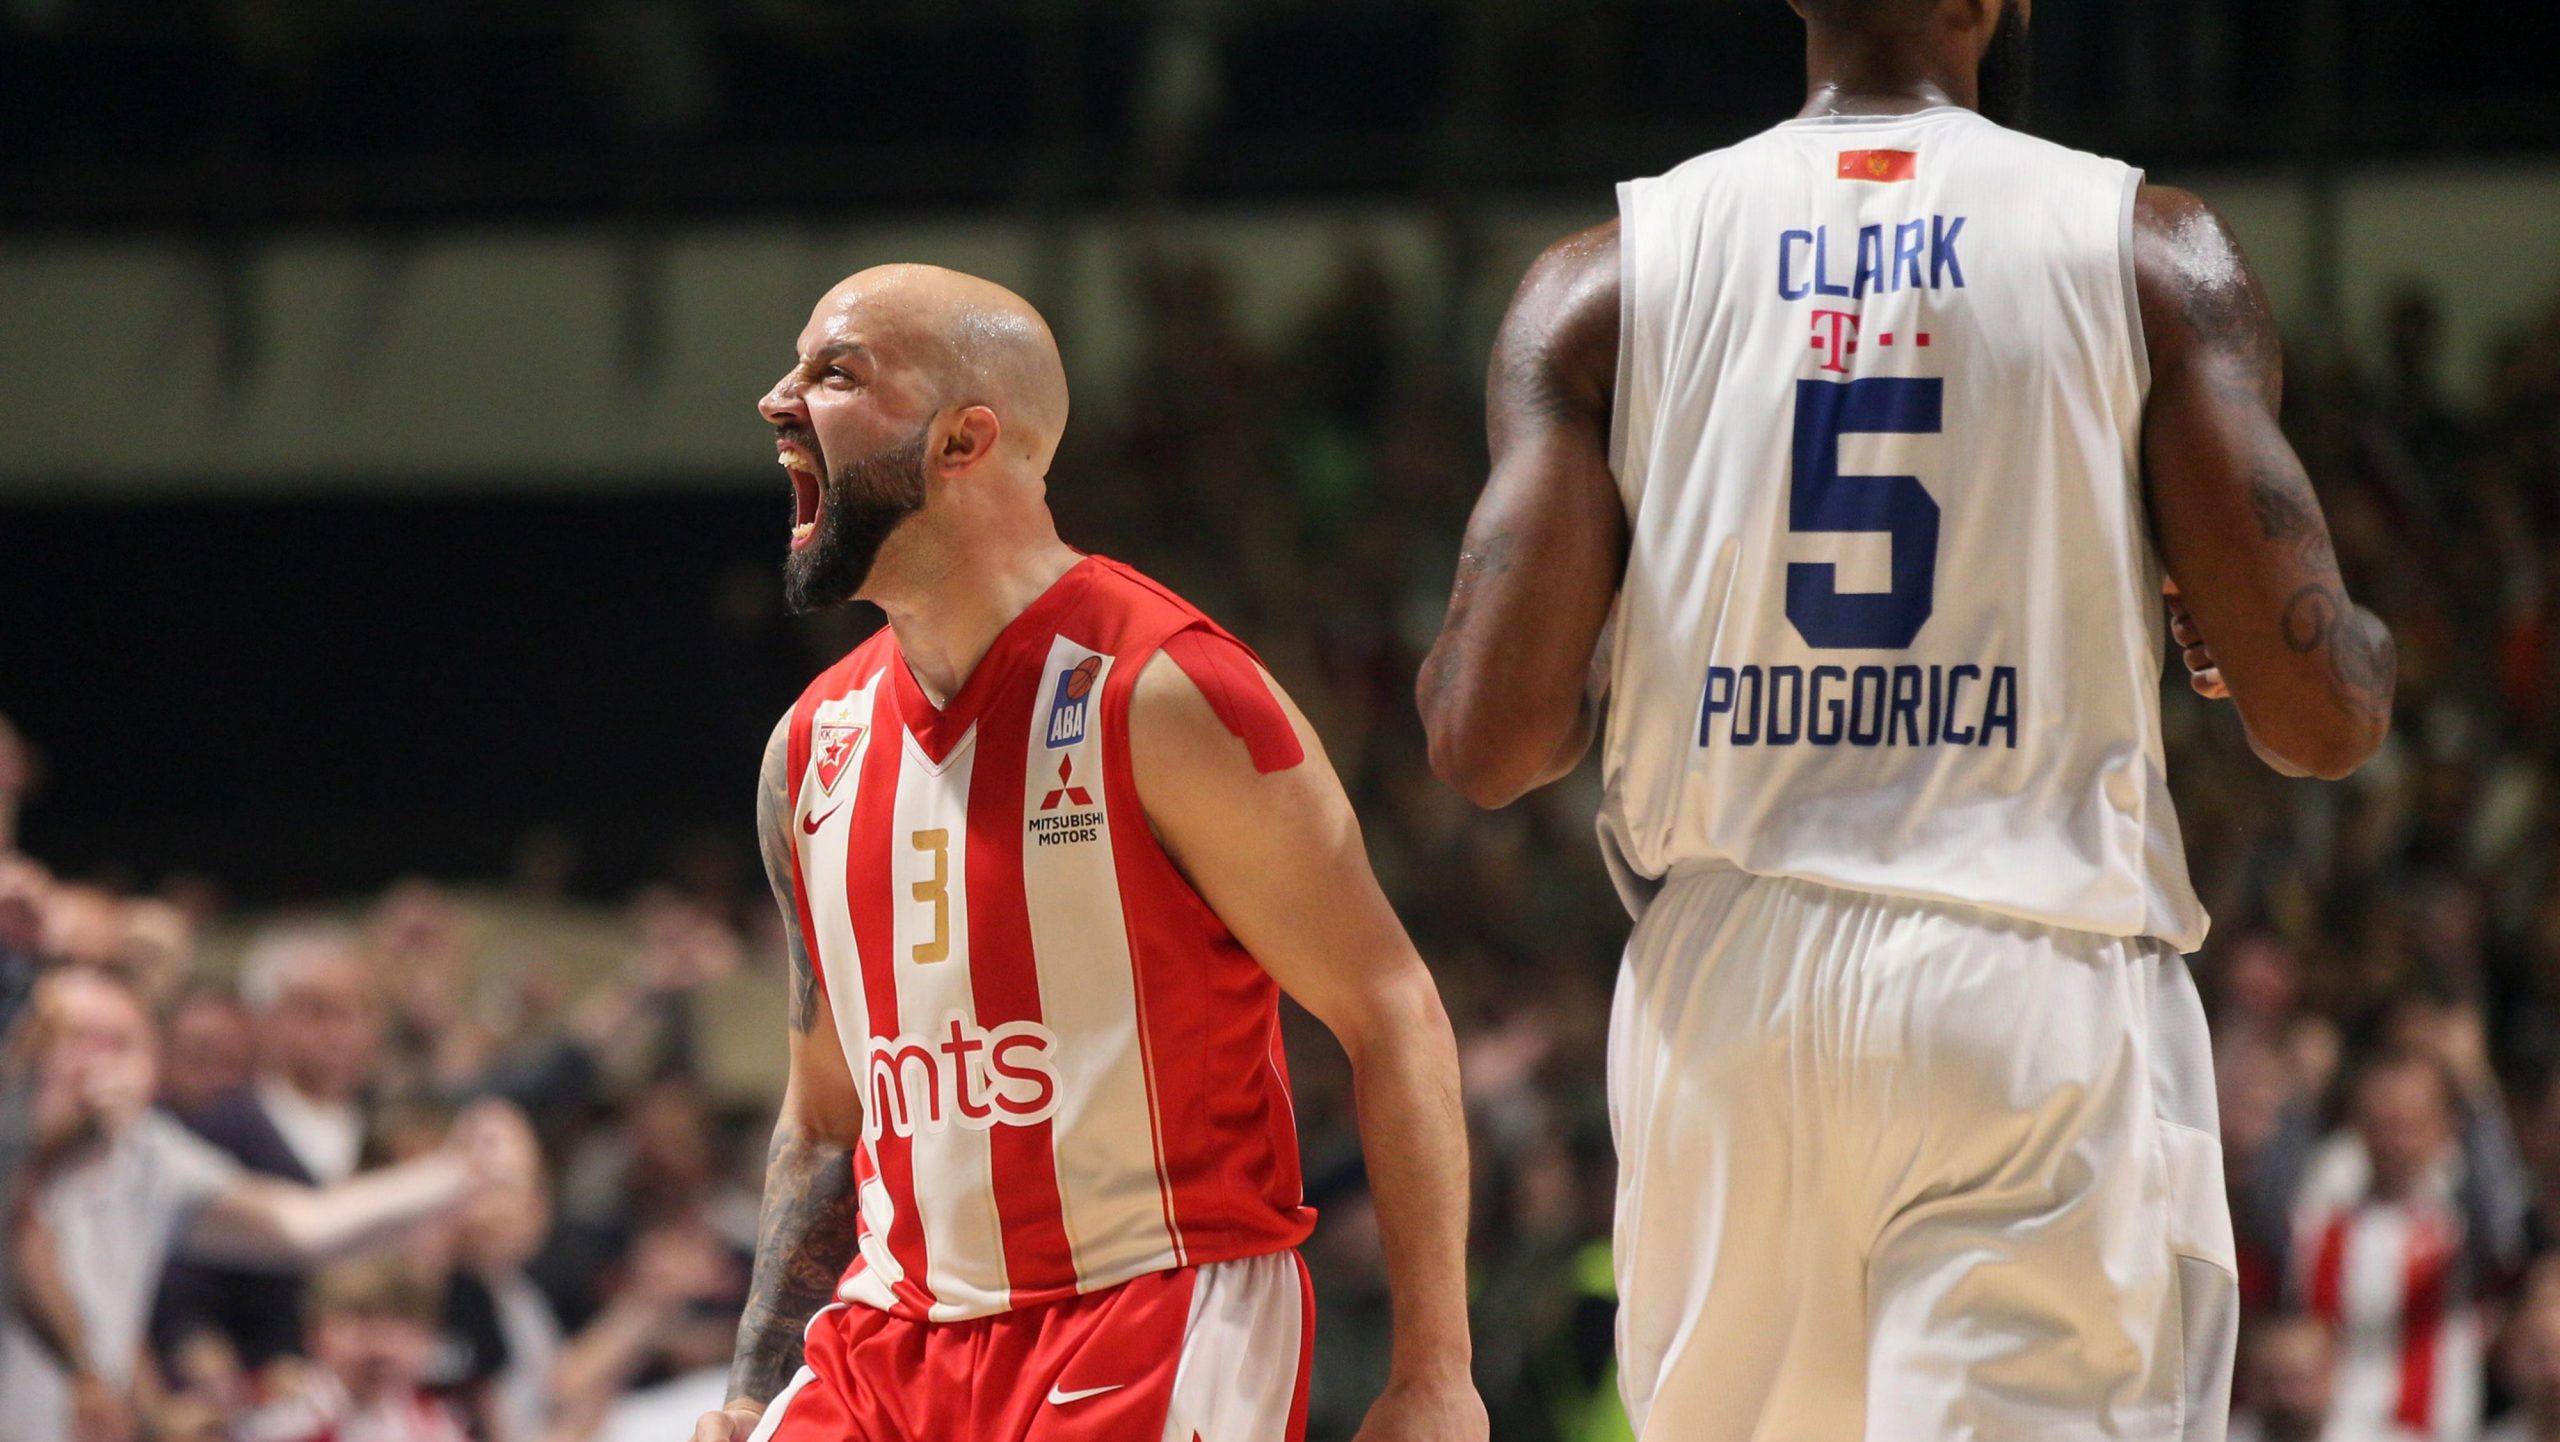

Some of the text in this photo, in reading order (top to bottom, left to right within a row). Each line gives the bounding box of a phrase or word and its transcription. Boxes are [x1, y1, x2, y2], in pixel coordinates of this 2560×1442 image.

[1778, 215, 1968, 301] CLARK
[1785, 377, 1943, 649] 5
[1051, 703, 1084, 742] ABA
[1699, 664, 2018, 748] PODGORICA
[1029, 812, 1104, 832] MITSUBISHI
[1039, 828, 1097, 846] MOTORS
[912, 828, 949, 964] 3
[870, 1019, 1055, 1128] mts
